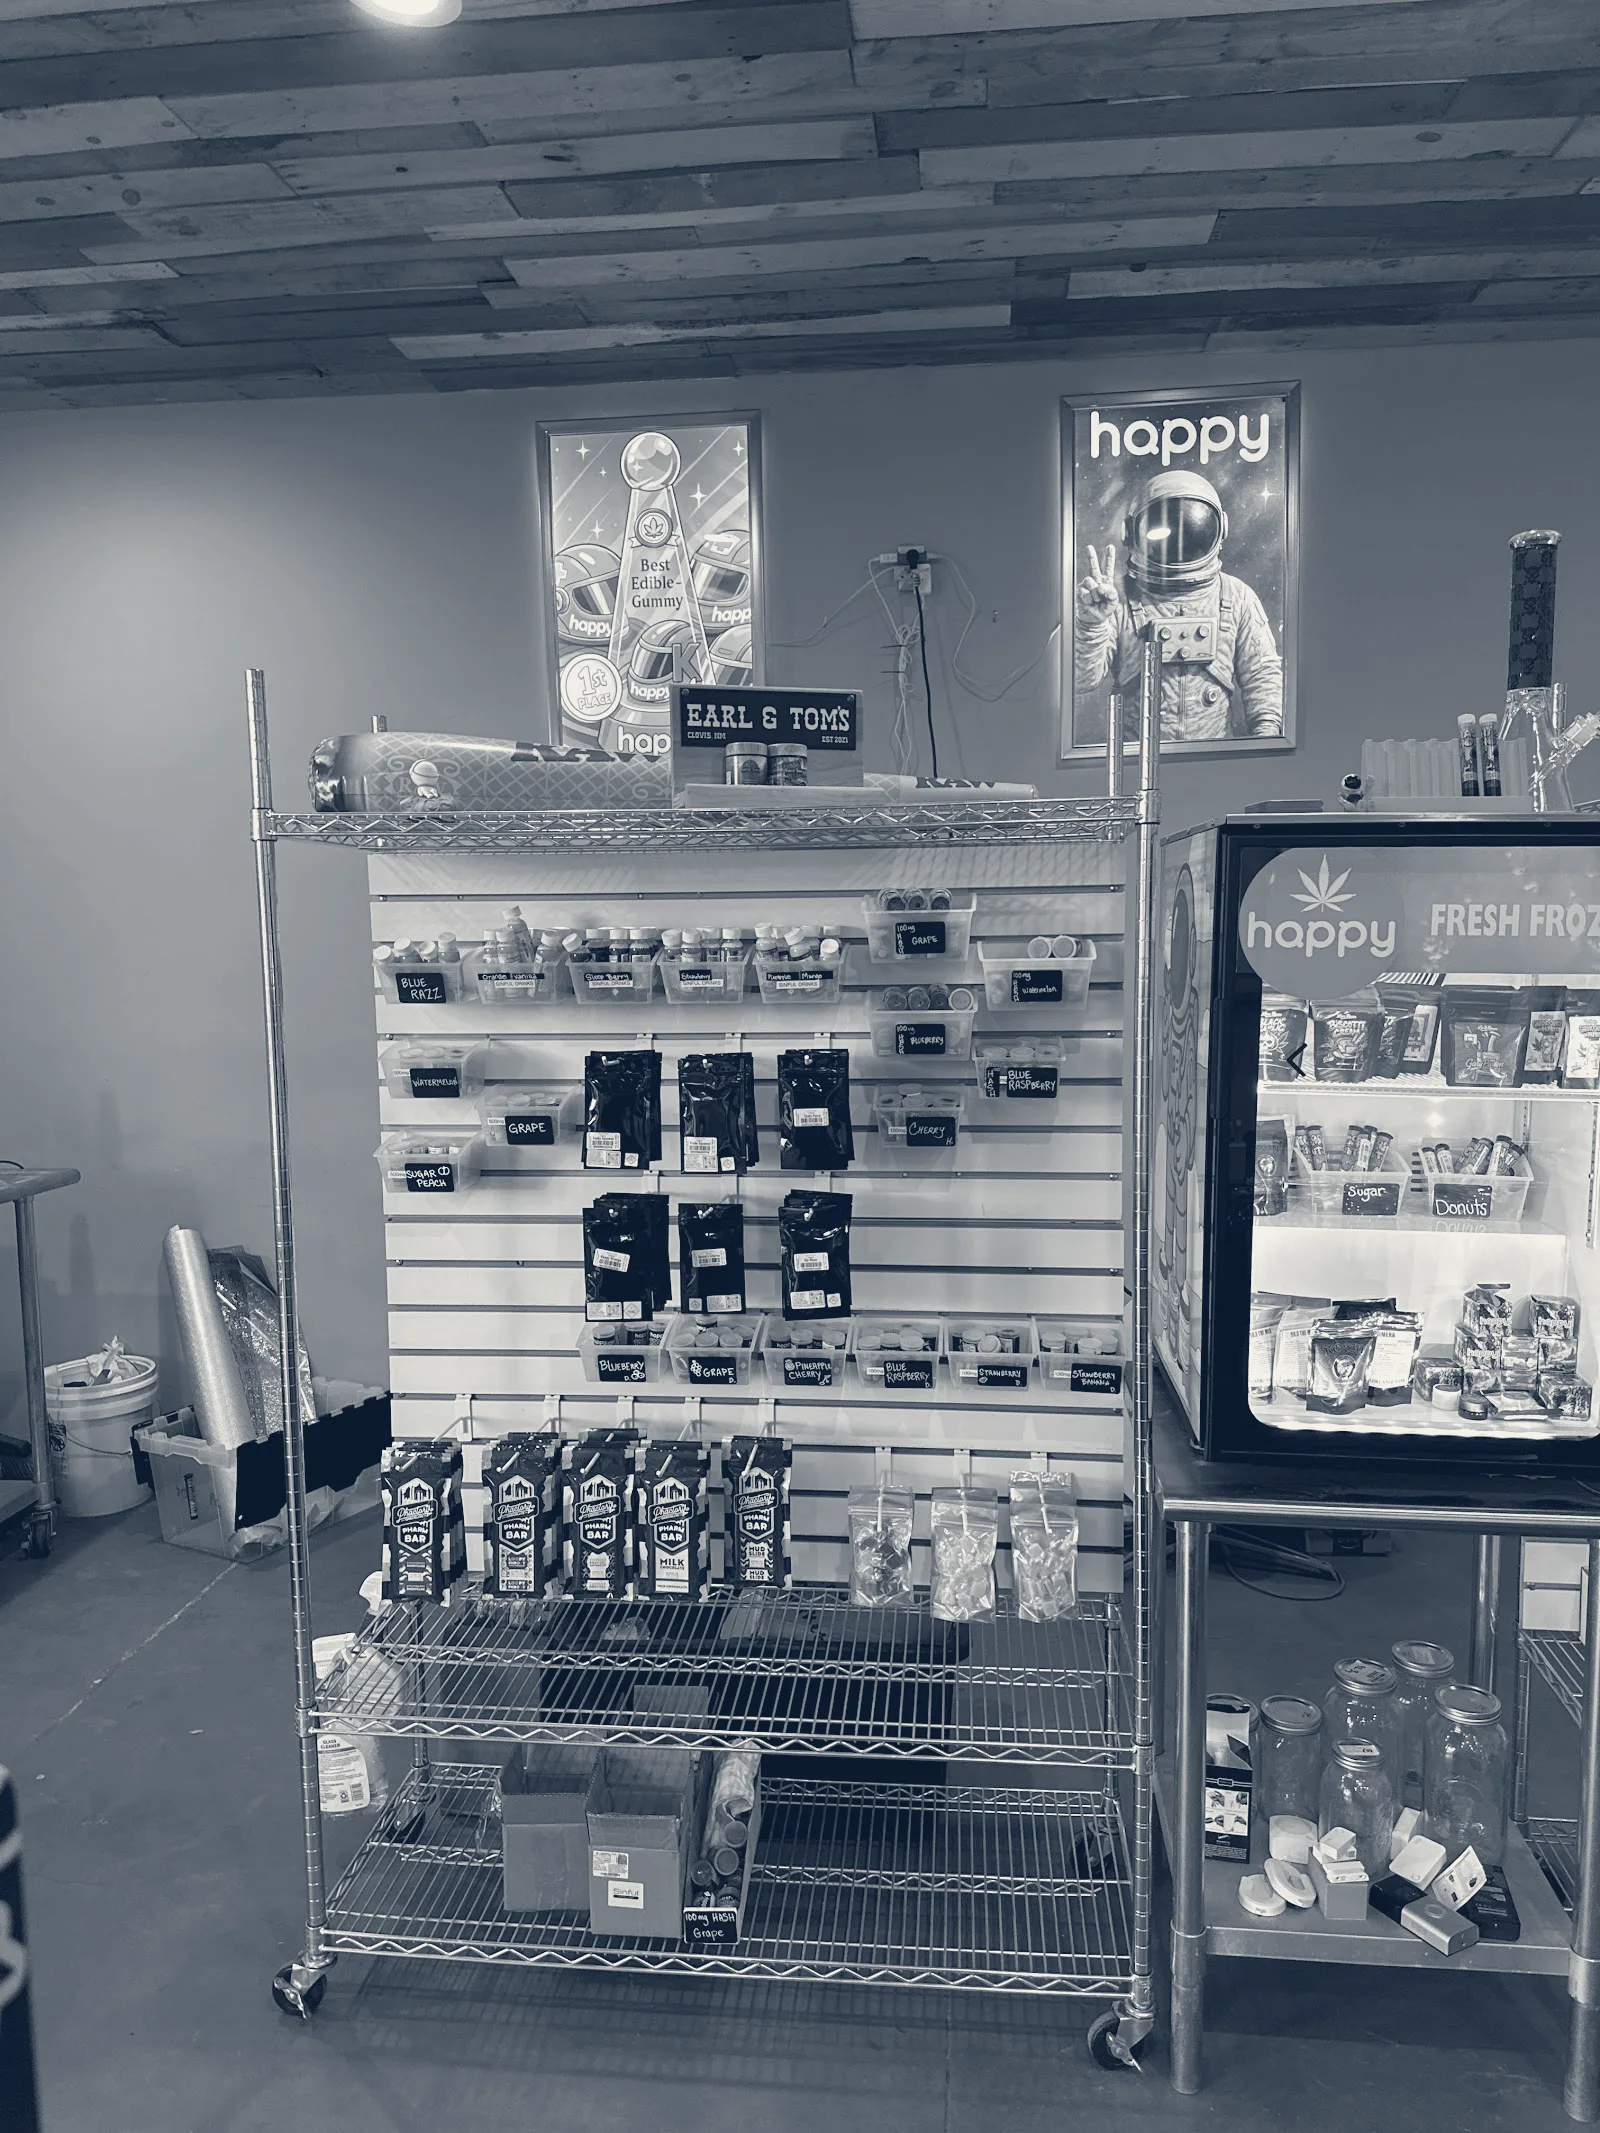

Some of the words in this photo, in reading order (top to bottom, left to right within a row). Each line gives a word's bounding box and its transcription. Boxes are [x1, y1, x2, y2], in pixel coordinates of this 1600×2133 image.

[1090, 410, 1270, 467] happy
[641, 558, 671, 572] Best
[632, 594, 684, 611] Gummy
[569, 614, 611, 637] happy
[578, 666, 608, 696] 1st
[577, 693, 611, 711] PLACE
[686, 703, 753, 729] EARL
[762, 705, 777, 730] &
[789, 705, 850, 732] TOM'S
[714, 732, 727, 740] NM
[821, 735, 834, 743] EST
[834, 736, 849, 744] 2021
[1430, 904, 1520, 937] FRESH
[1246, 911, 1396, 958] happy
[911, 935, 939, 946] GRAPE
[401, 976, 428, 989] BLUE
[410, 987, 443, 1001] RAZZ
[909, 1036, 944, 1046] BLUEBERRY
[1008, 1070, 1033, 1079] BLUE
[412, 1077, 458, 1088] WATERMELON
[1008, 1080, 1056, 1092] RASPBERRY
[508, 1122, 547, 1134] GRAPE
[406, 1169, 437, 1179] SUGAR
[416, 1179, 447, 1188] PEACH
[1348, 1185, 1385, 1202] Sugar
[1435, 1198, 1488, 1216] Donuts
[599, 1360, 645, 1372] BLUEBERRY
[885, 1362, 907, 1372] BLUE
[703, 1367, 735, 1377] GRAPE
[788, 1371, 821, 1381] CHERRY
[886, 1371, 930, 1384] RASPBERRY
[1071, 1369, 1116, 1380] STRAWBERRY
[743, 1514, 770, 1522] PHARM
[402, 1526, 429, 1534] PHARM
[503, 1523, 530, 1531] PHARM
[584, 1523, 611, 1531] PHARM
[658, 1525, 685, 1533] PHARM
[745, 1521, 768, 1531] BAR
[404, 1534, 427, 1543] BAR
[505, 1530, 528, 1539] BAR
[586, 1530, 609, 1539] BAR
[660, 1533, 683, 1542] BAR
[660, 1558, 685, 1567] MILK
[613, 1887, 639, 1896] Sinful
[685, 1912, 709, 1927] 100mg
[712, 1912, 735, 1922] HASH
[693, 1928, 725, 1941] Grape
